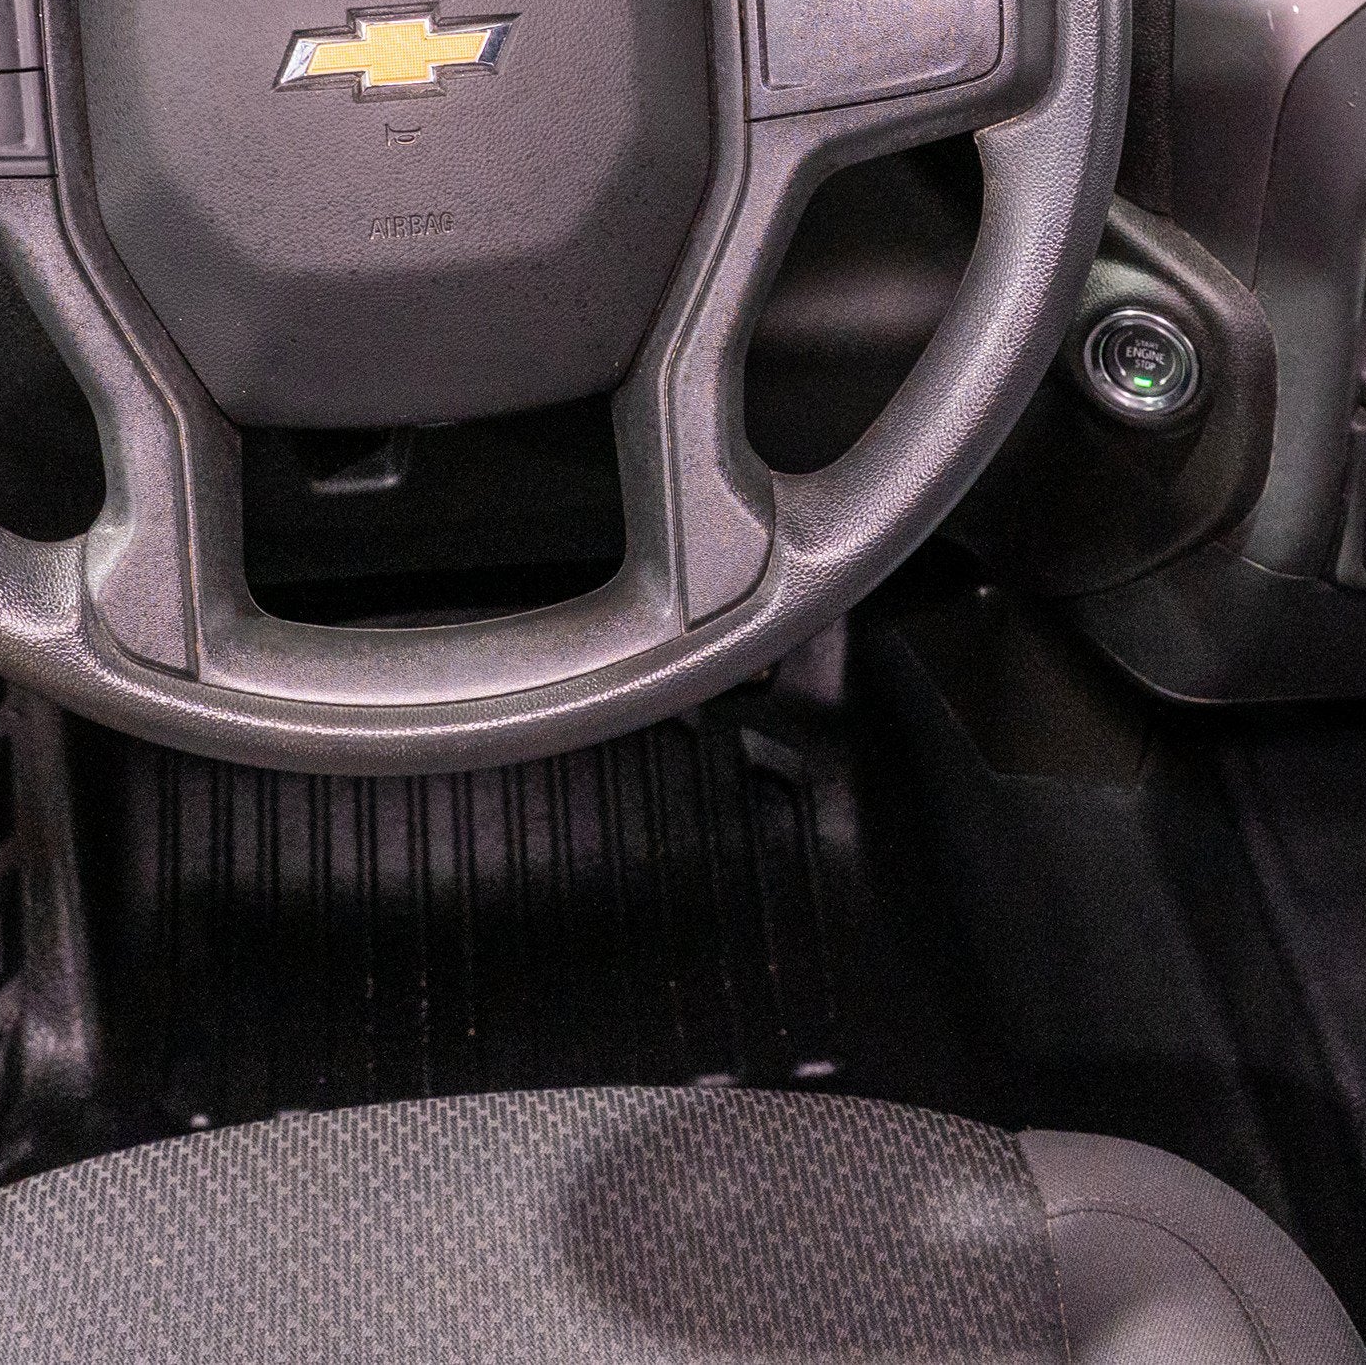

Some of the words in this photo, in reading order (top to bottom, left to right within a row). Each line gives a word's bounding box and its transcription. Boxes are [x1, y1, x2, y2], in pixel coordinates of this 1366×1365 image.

[370, 211, 454, 241] AIRBAG
[1125, 346, 1165, 366] ENGINE
[1135, 359, 1156, 370] STOP
